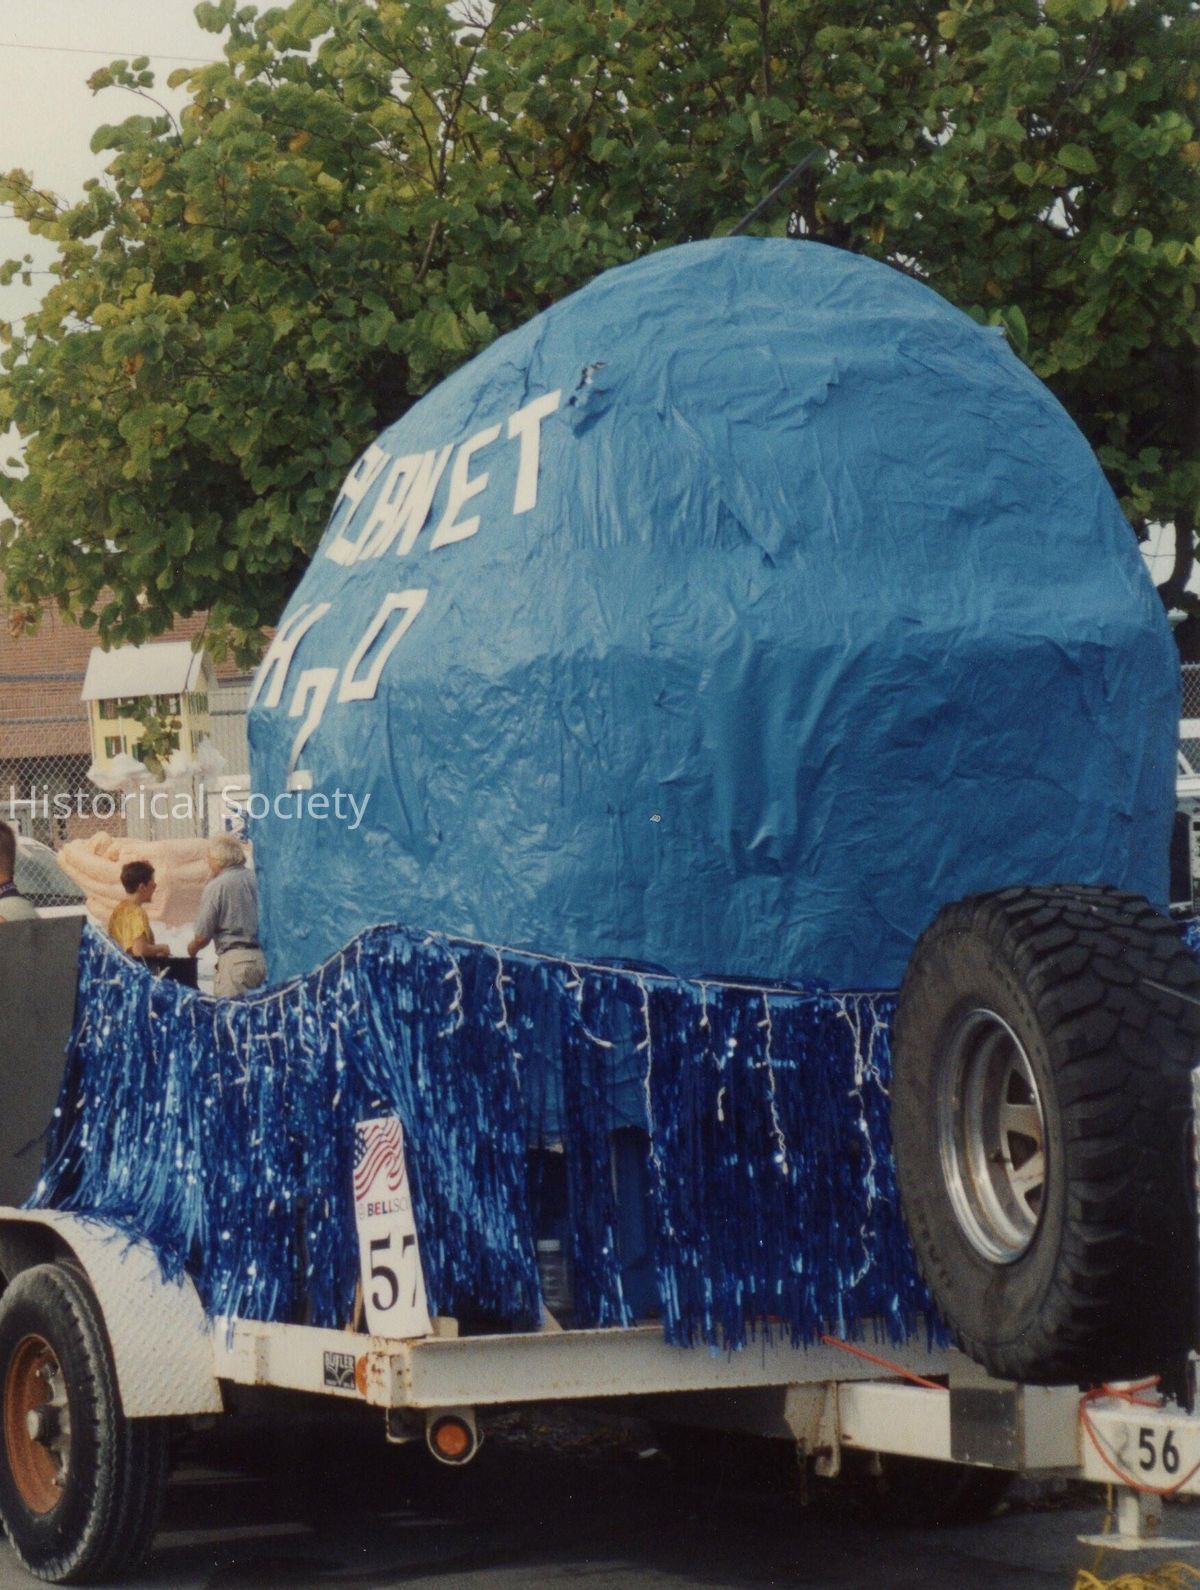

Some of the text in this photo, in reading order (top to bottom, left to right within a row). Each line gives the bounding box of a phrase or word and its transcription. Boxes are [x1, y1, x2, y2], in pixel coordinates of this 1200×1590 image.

[324, 389, 562, 566] PLANET
[370, 1233, 417, 1311] 57
[1139, 1427, 1180, 1474] 56
